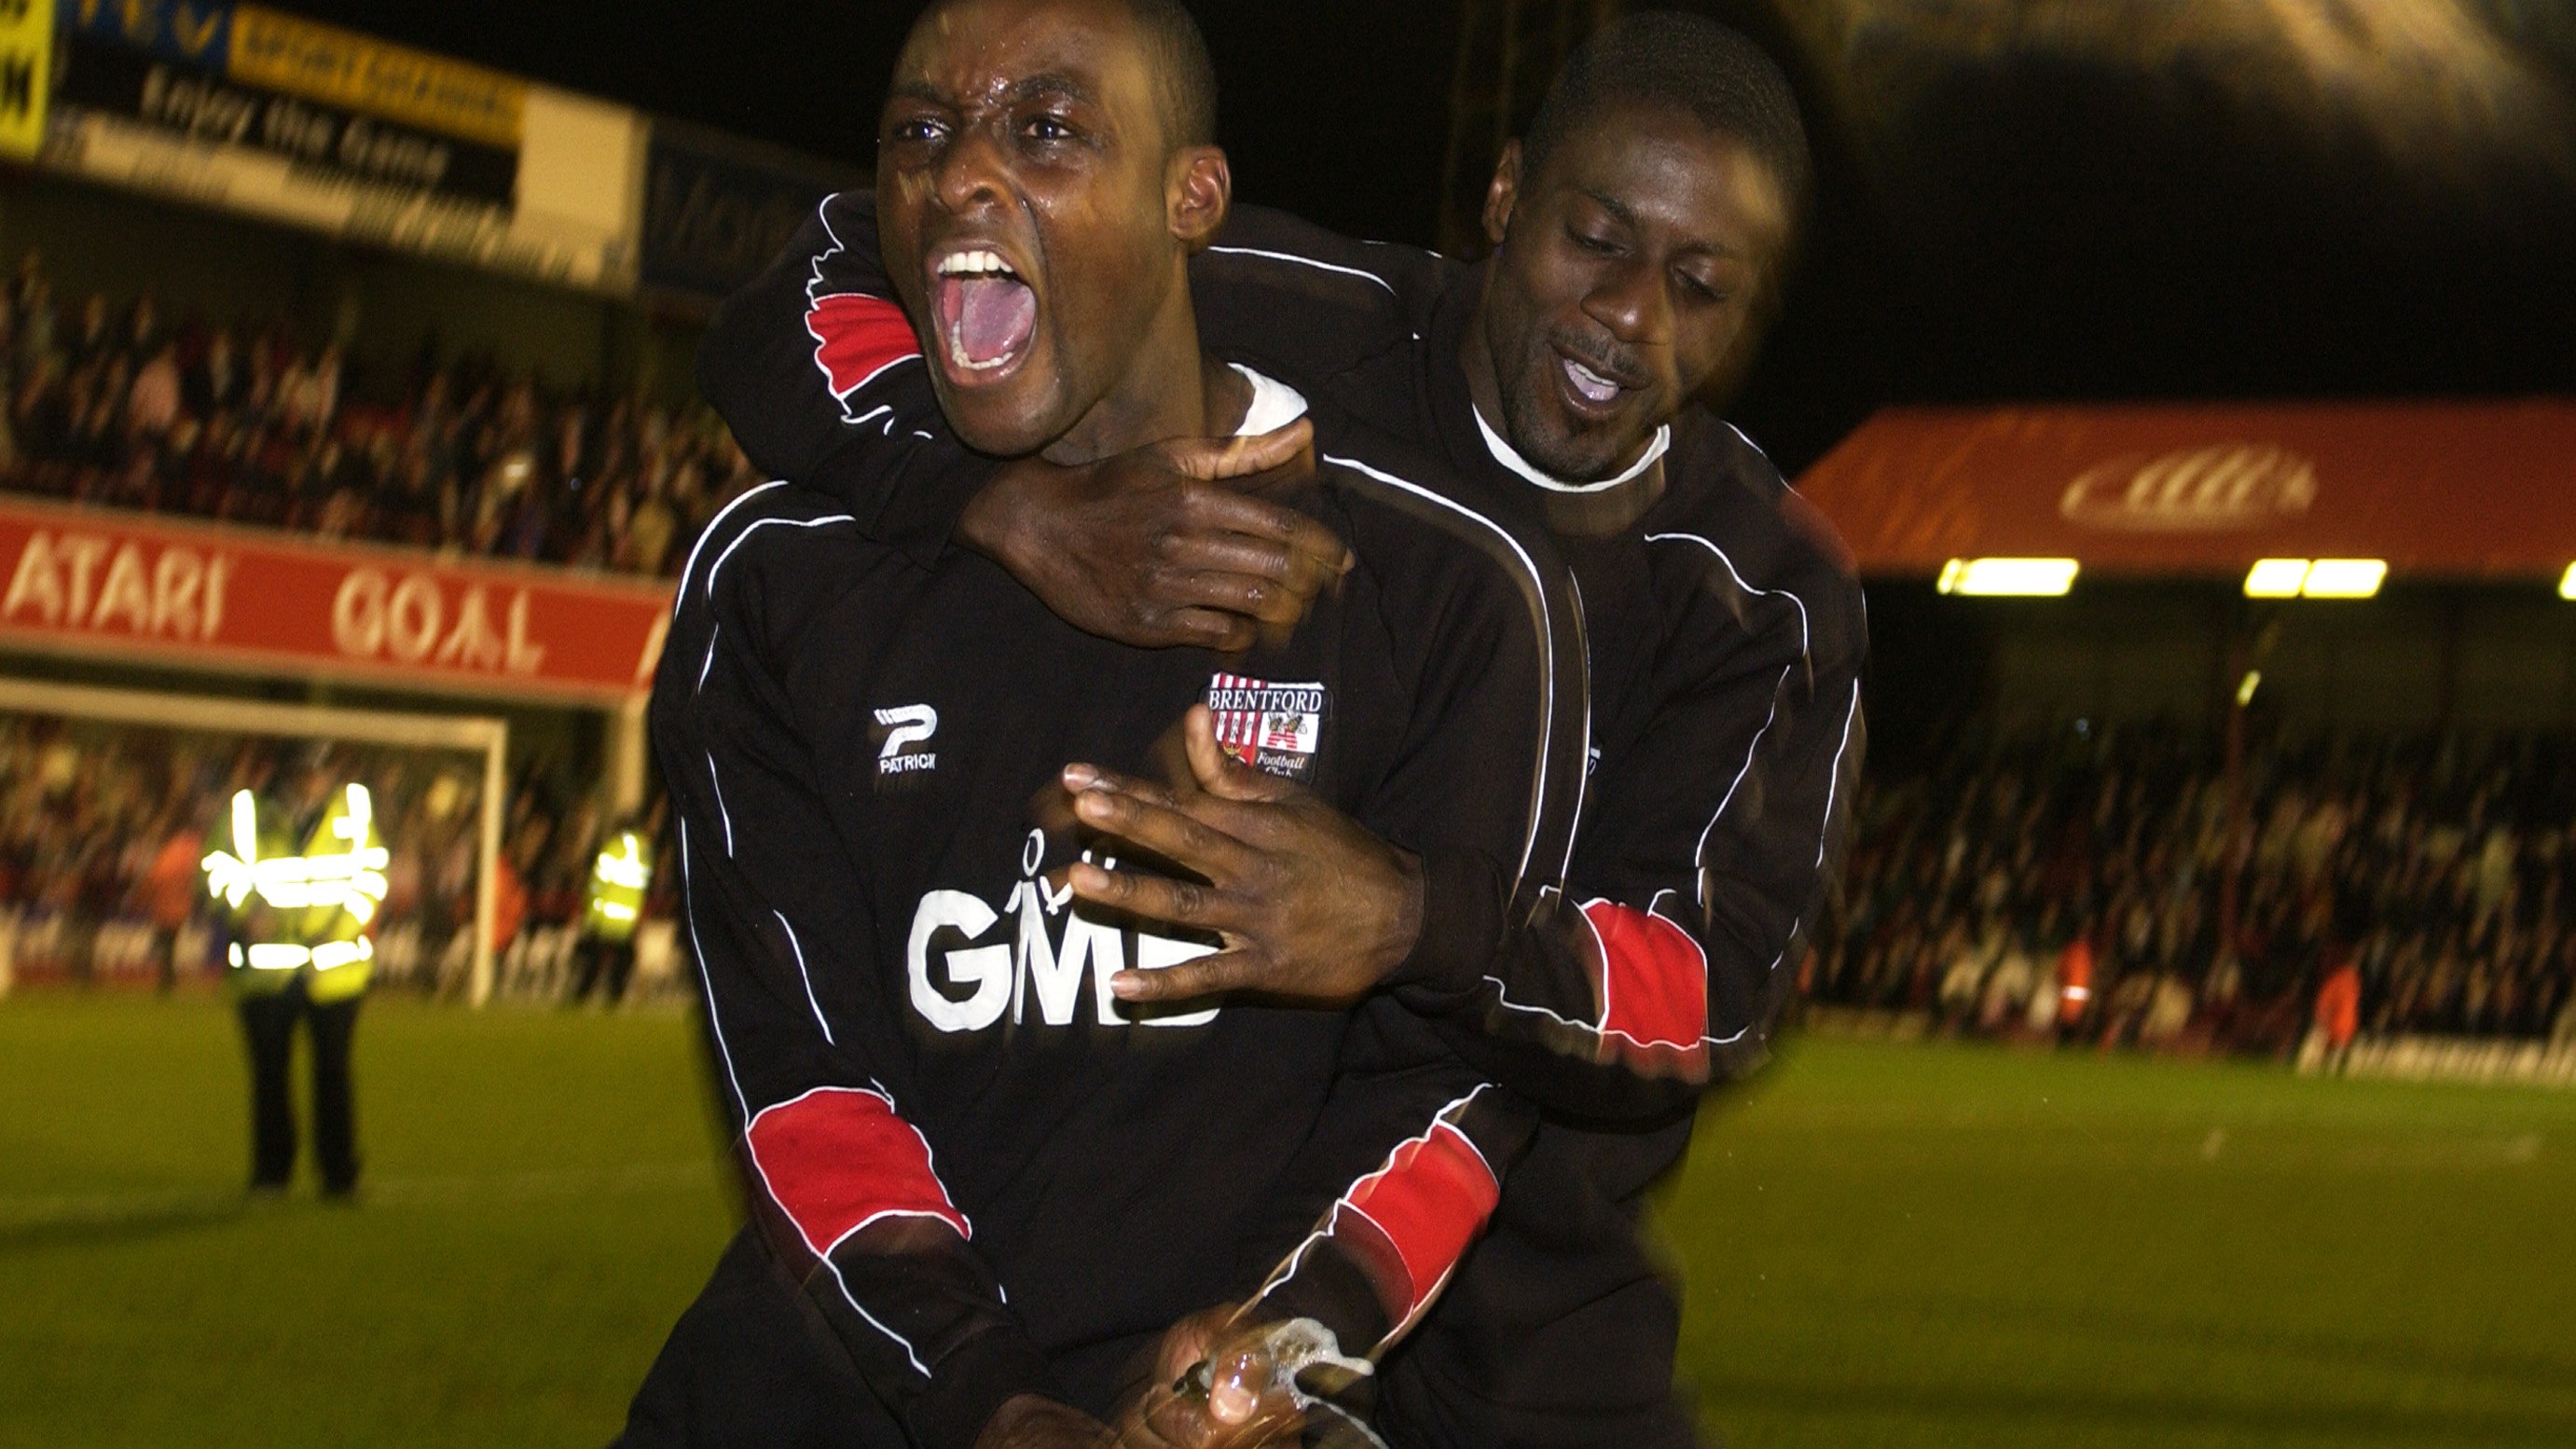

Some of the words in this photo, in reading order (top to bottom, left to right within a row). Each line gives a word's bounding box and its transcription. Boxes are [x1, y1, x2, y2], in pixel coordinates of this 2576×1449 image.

[3, 530, 231, 643] ATARI
[331, 565, 548, 677] GOAL
[1208, 688, 1322, 712] BRENTFORD
[878, 752, 937, 775] PATRICK
[1257, 752, 1305, 770] Football
